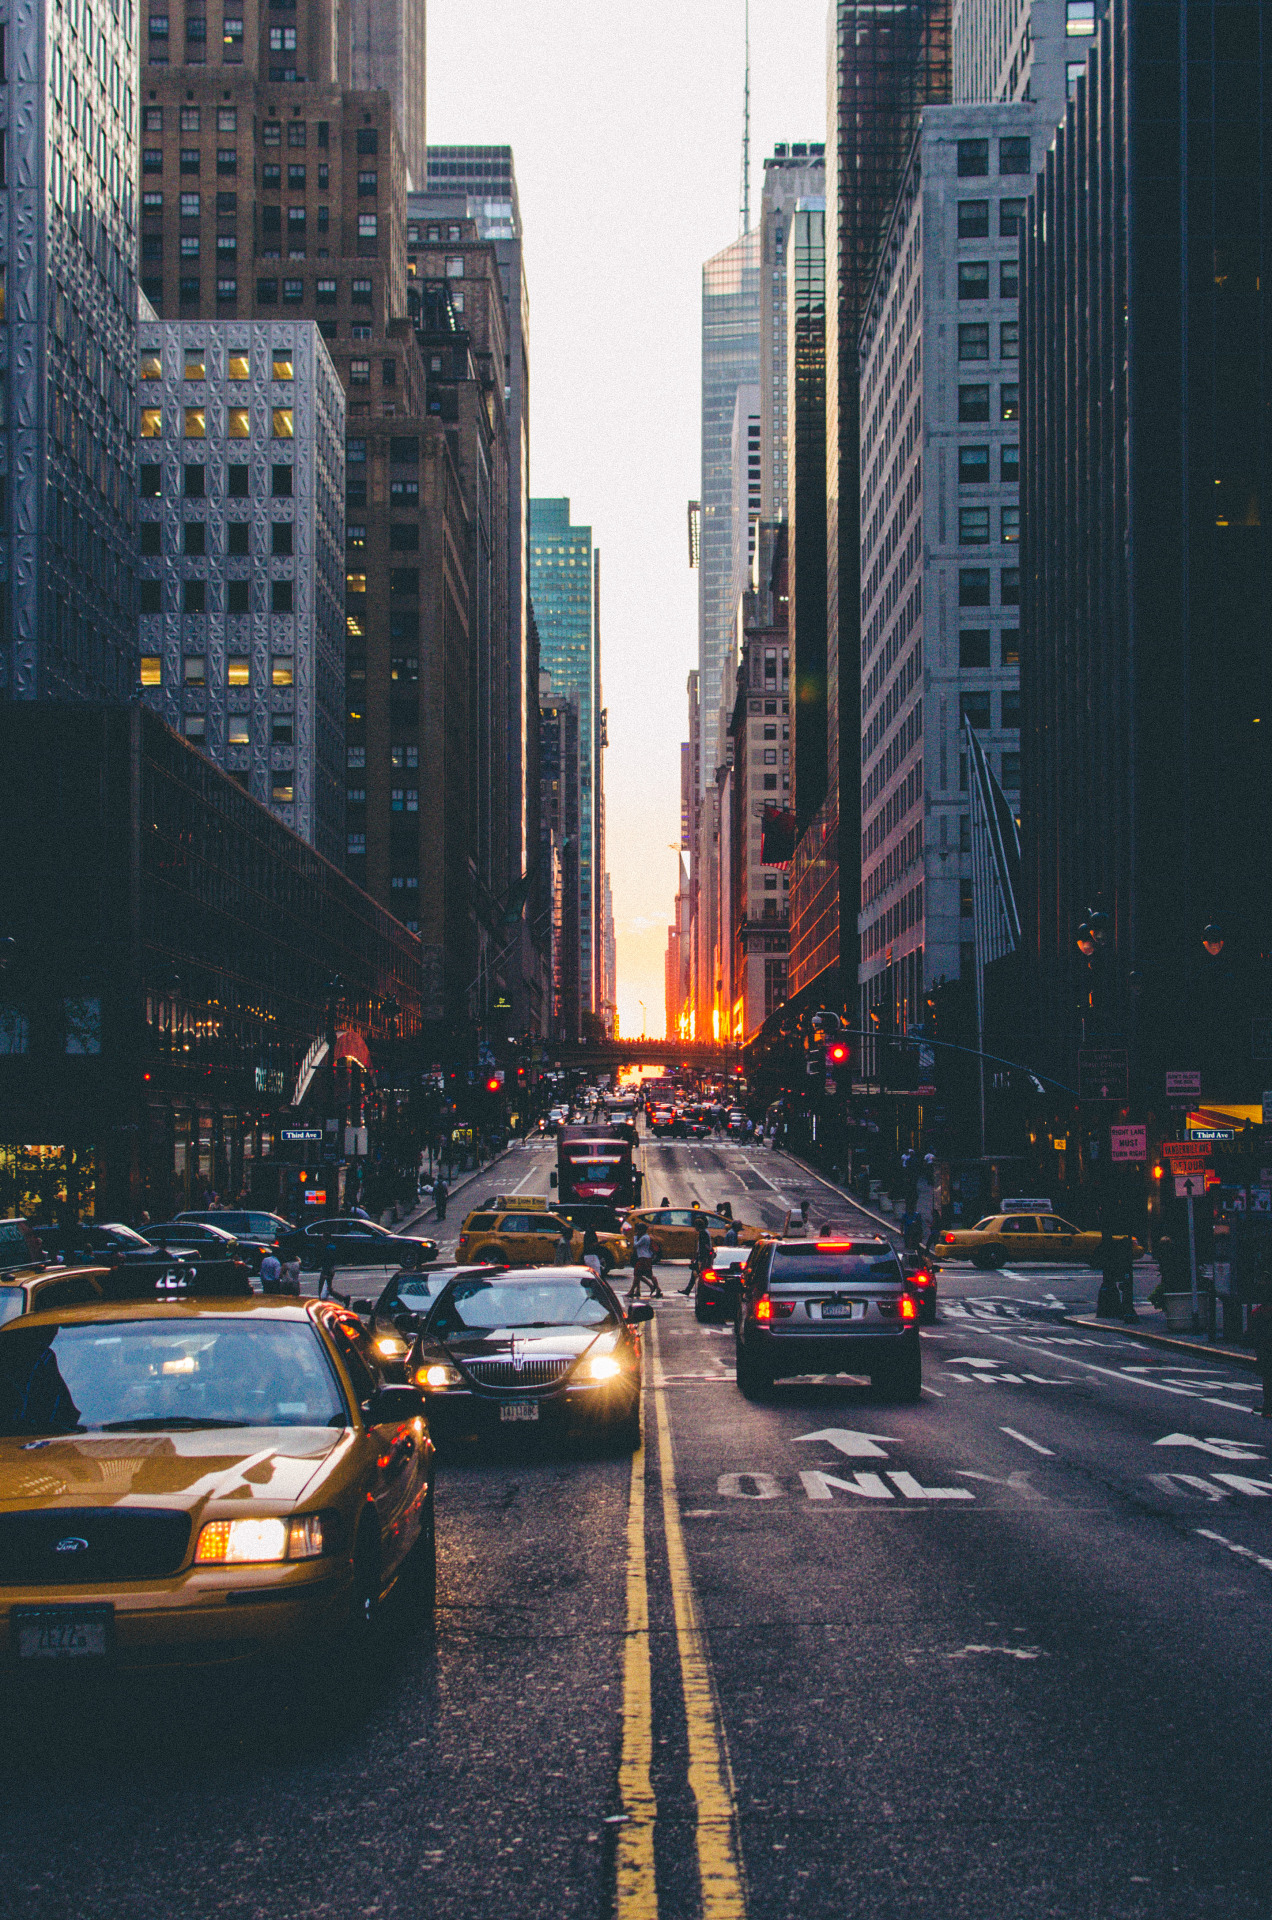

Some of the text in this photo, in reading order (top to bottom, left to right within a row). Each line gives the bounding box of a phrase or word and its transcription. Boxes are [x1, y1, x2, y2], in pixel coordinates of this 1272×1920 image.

[1197, 1131, 1230, 1139] Third Ave
[1119, 1139, 1138, 1147] MUST
[1165, 1143, 1210, 1155] VANDERBILT AVE
[1173, 1160, 1205, 1172] DETOUR
[155, 1266, 198, 1289] 2E22
[55, 1540, 79, 1552] Ford
